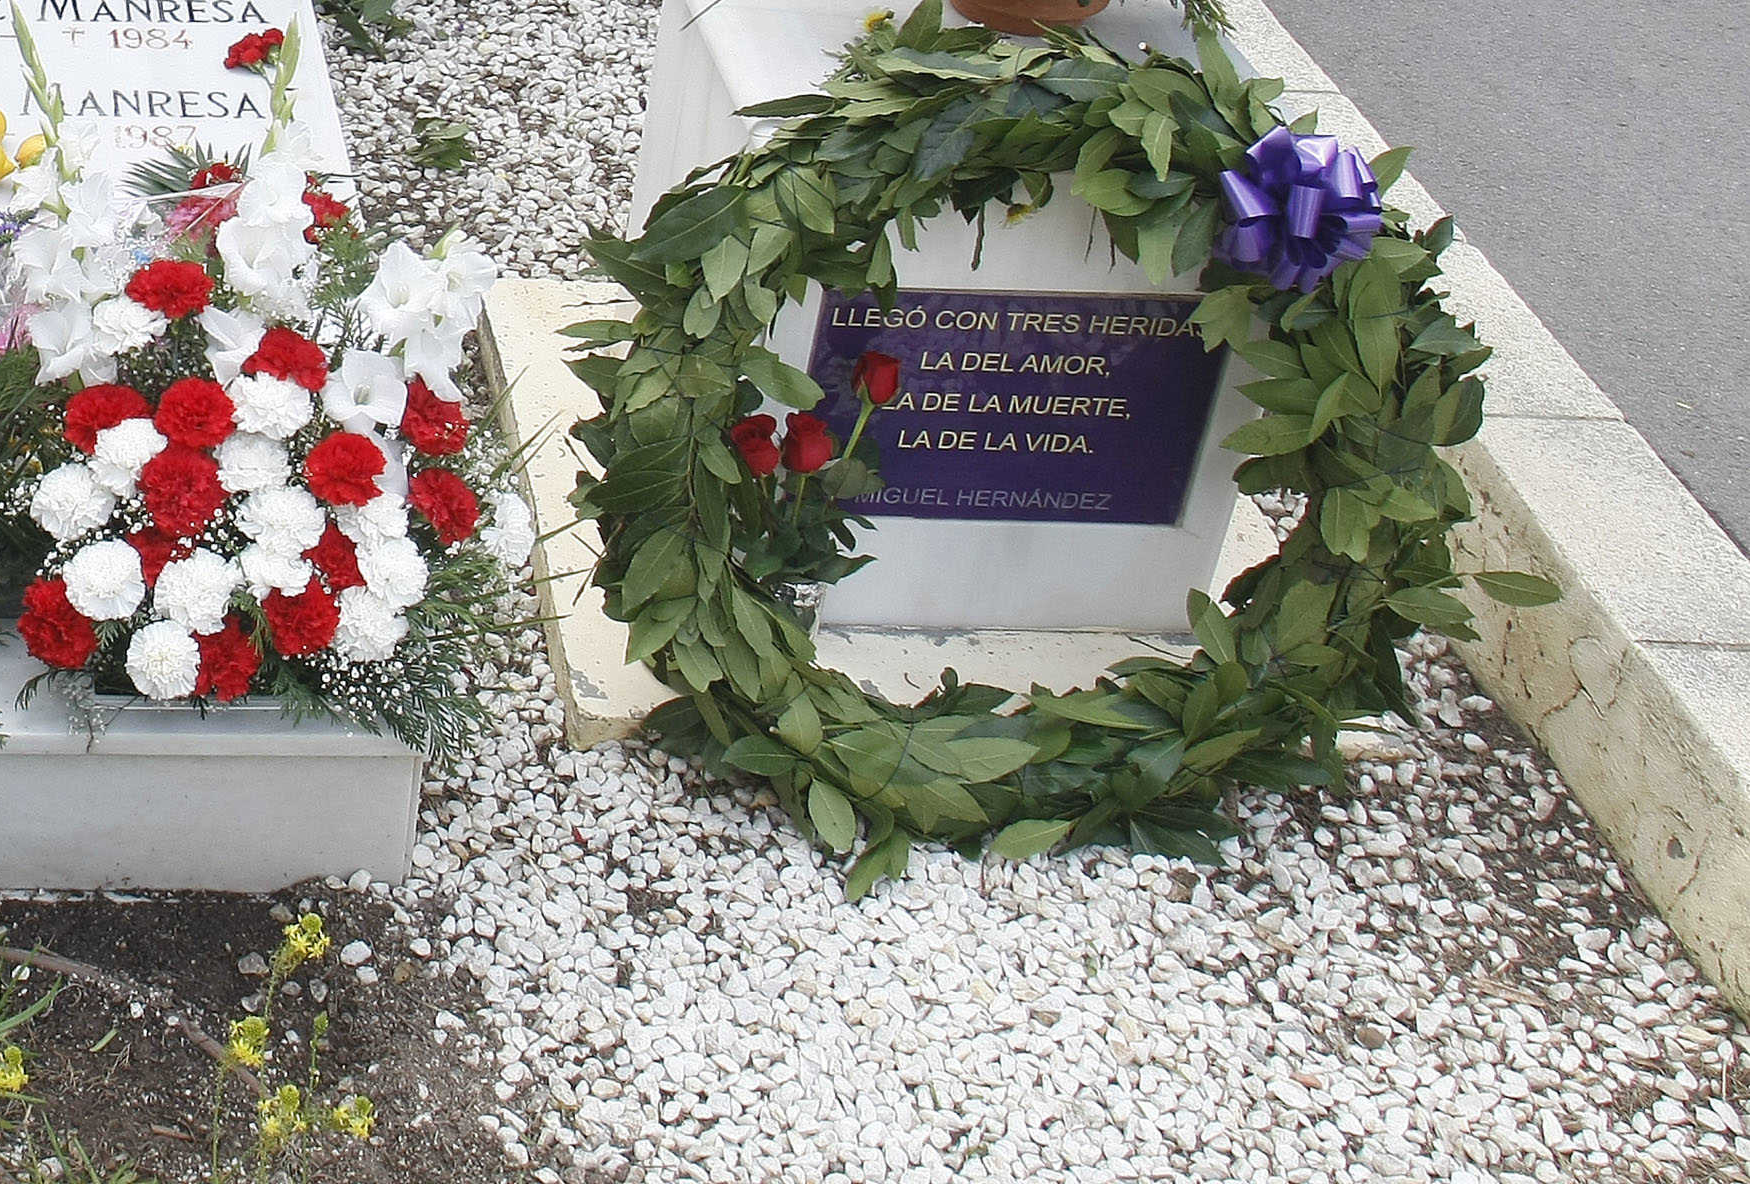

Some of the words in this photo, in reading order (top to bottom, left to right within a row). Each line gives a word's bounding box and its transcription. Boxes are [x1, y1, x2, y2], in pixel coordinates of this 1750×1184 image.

[108, 28, 193, 50] 1984
[832, 305, 927, 329] LLEGÓ
[935, 310, 998, 331] CON
[1007, 312, 1081, 334] TRES
[1088, 315, 1203, 337] HERIDA
[920, 352, 955, 371] LA
[961, 353, 1014, 373] DEL
[1019, 354, 1110, 378] AMOR,
[922, 392, 962, 412] DE
[968, 394, 1002, 413] LA
[1008, 395, 1130, 420] MUERTE,
[897, 430, 931, 449] LA
[938, 431, 977, 450] DE
[984, 432, 1018, 452] LA
[1025, 433, 1094, 454] VIDA.
[956, 488, 1113, 510] HERNÁNDEZ
